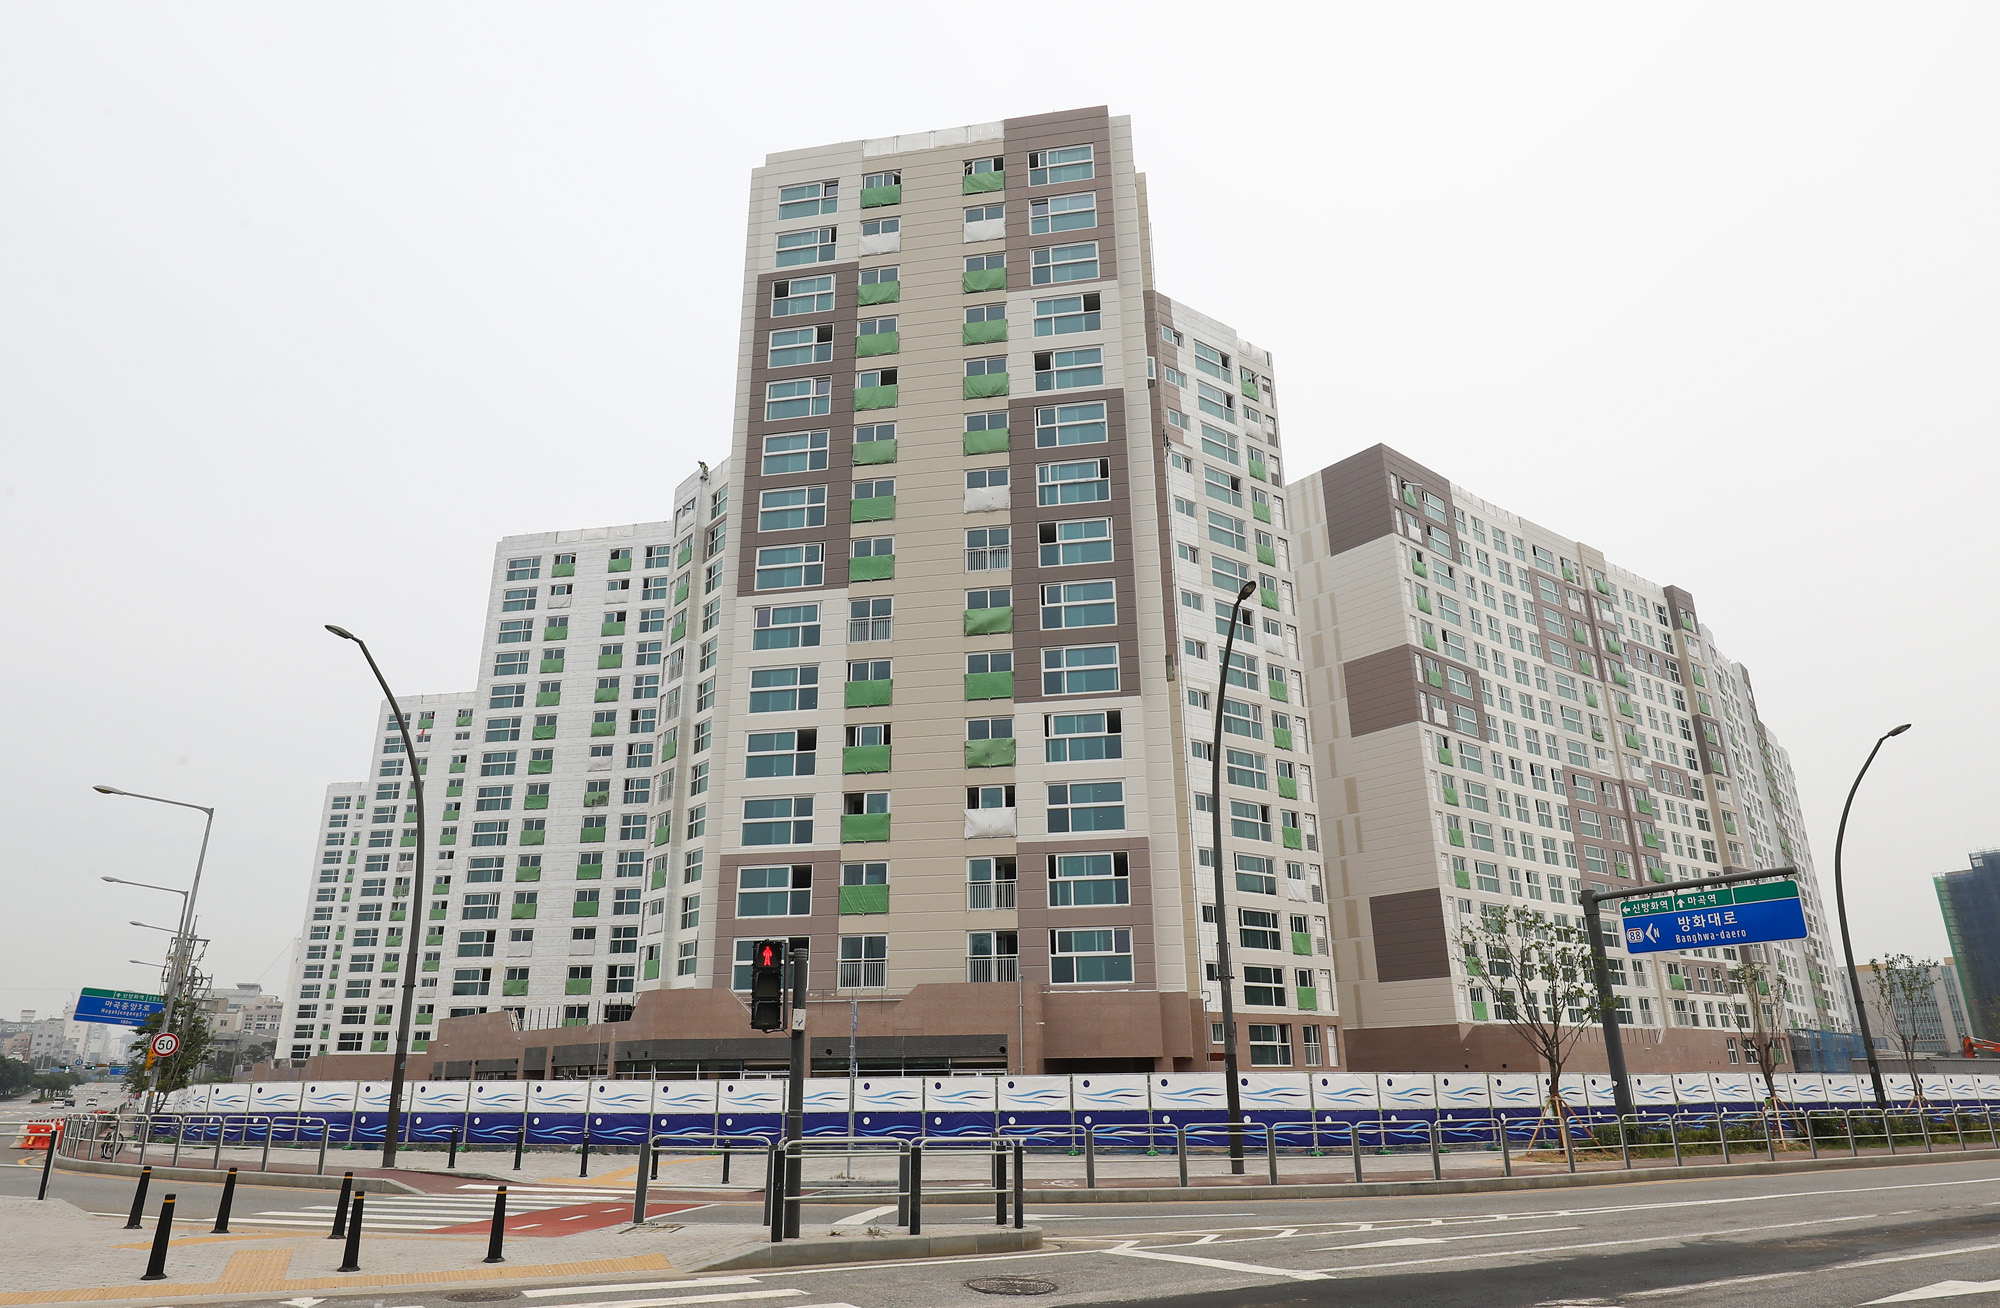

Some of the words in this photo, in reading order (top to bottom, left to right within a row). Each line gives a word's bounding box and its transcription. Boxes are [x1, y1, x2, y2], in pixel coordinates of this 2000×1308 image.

[1687, 894, 1717, 906] 마곡역
[1632, 900, 1669, 914] 신방화역
[1678, 911, 1738, 932] 방화대로
[1630, 931, 1641, 940] 88
[1676, 929, 1747, 944] Banghwa-daero
[105, 1000, 150, 1011] 마곡중앙3로
[157, 1040, 173, 1050] 50
